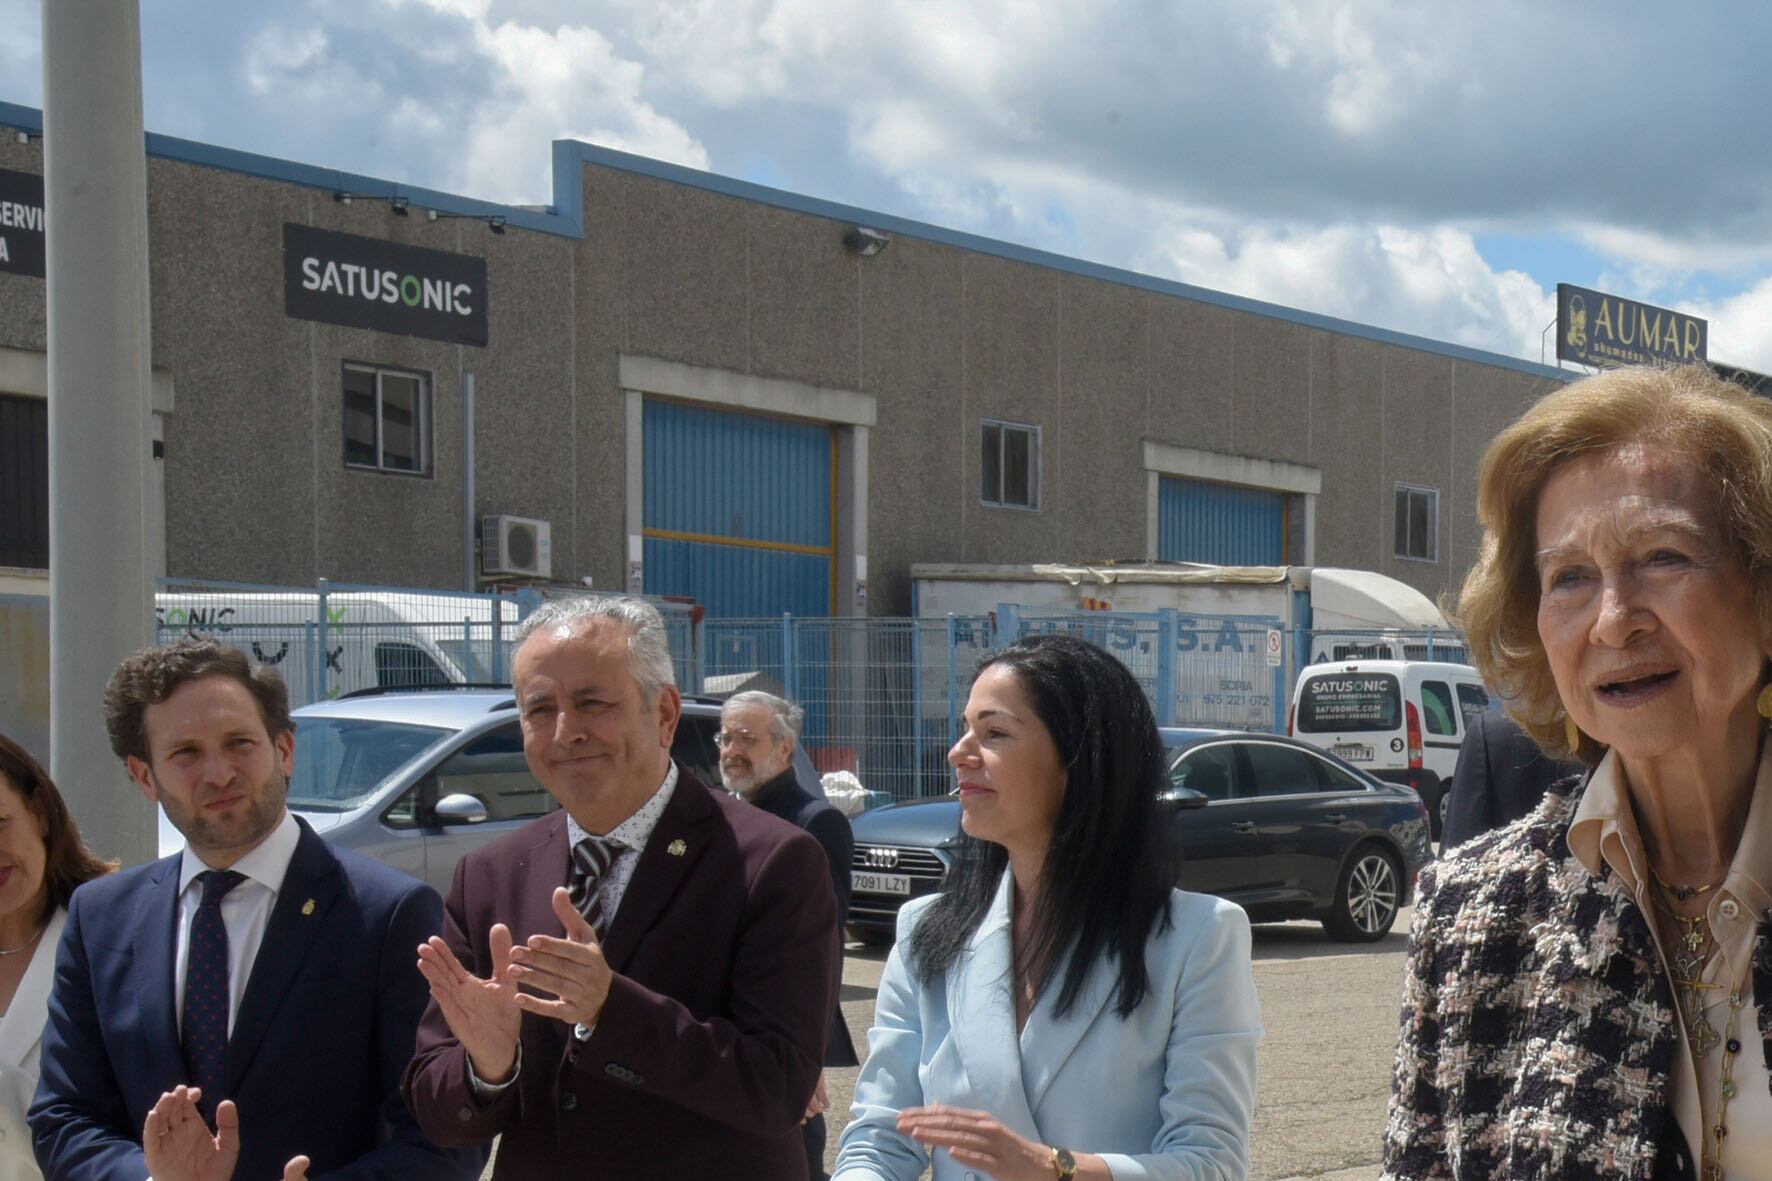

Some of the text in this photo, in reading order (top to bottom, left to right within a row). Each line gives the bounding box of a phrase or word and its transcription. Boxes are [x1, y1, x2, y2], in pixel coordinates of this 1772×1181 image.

[302, 256, 472, 316] SATUSONIC
[1594, 297, 1701, 361] AUMAR
[1312, 680, 1389, 694] SATUSONIC
[1393, 740, 1402, 752] 3
[854, 875, 907, 891] 7091 LZY
